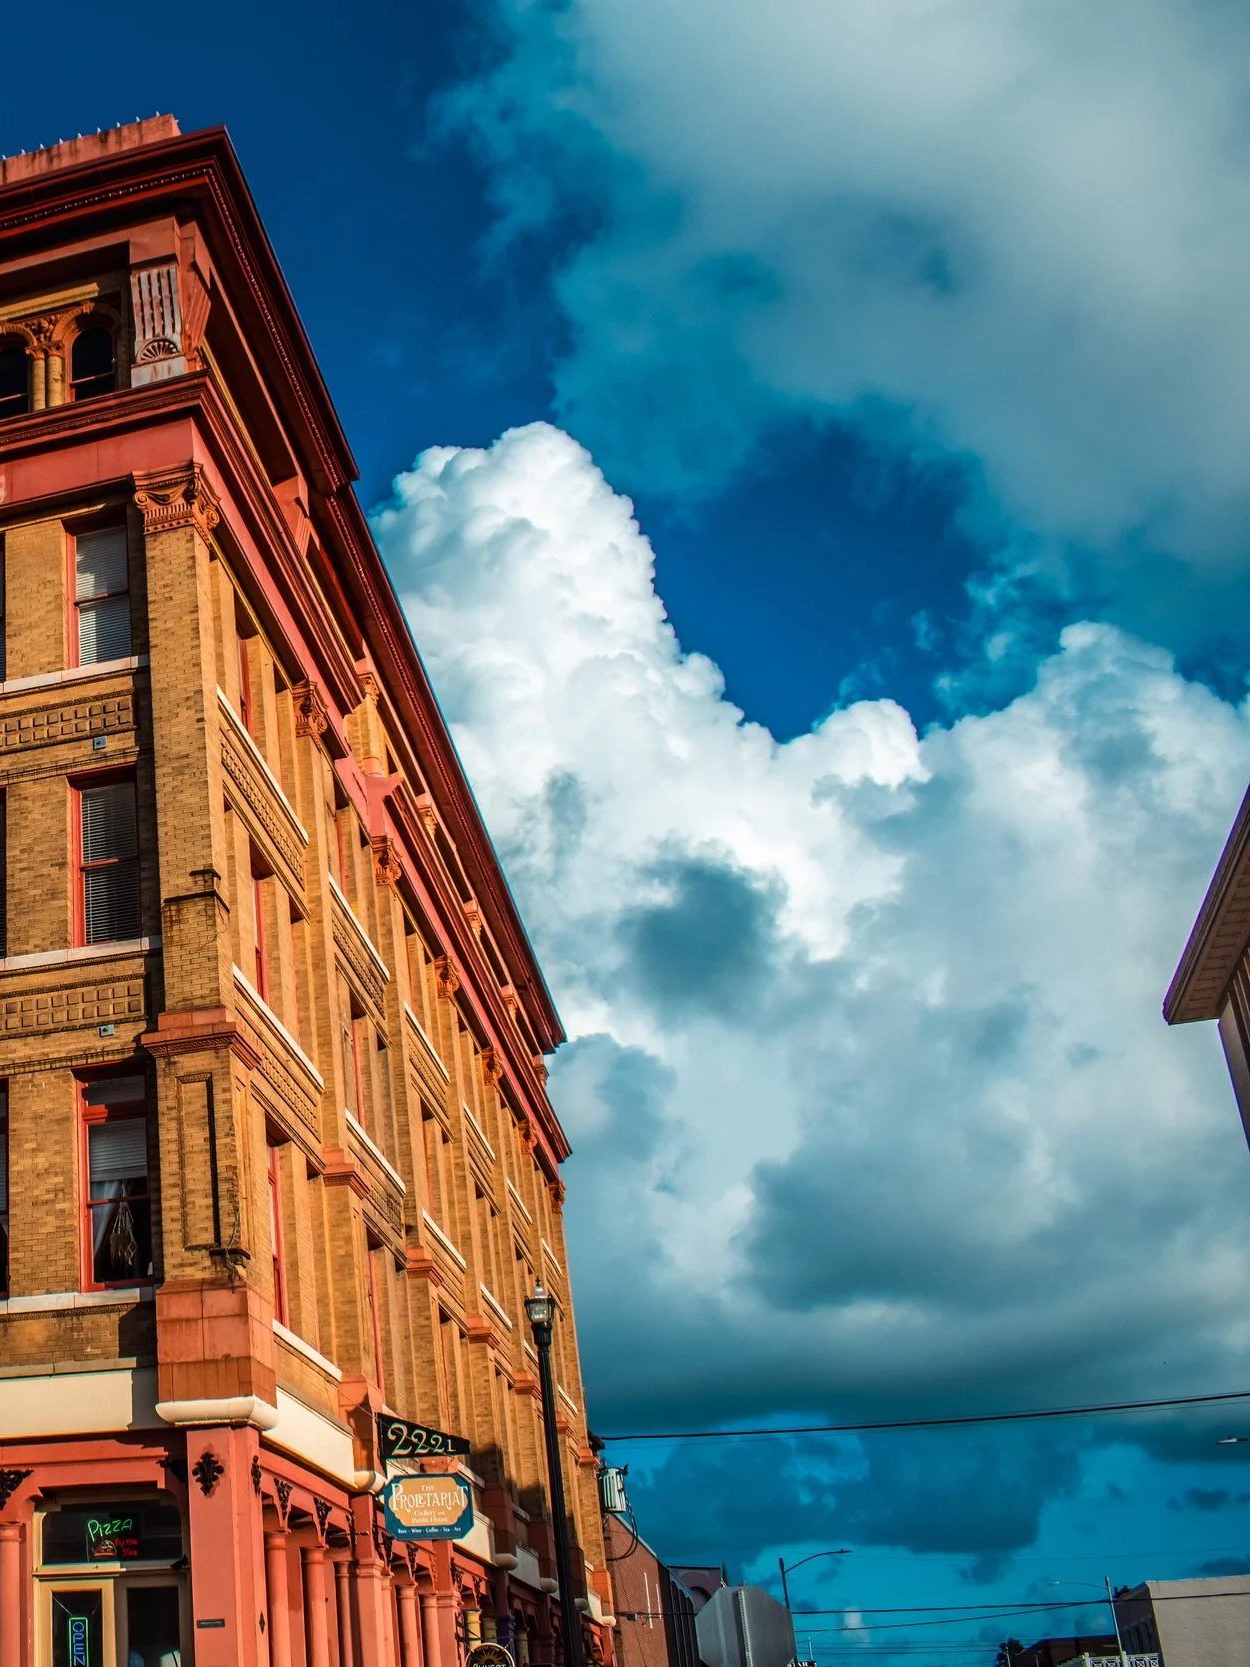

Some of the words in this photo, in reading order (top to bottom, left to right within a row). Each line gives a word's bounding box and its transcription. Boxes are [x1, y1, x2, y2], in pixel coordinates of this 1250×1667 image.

[387, 1422, 457, 1457] 2221
[391, 1483, 468, 1513] PROLETARIAT
[72, 1621, 86, 1666] OPEN
